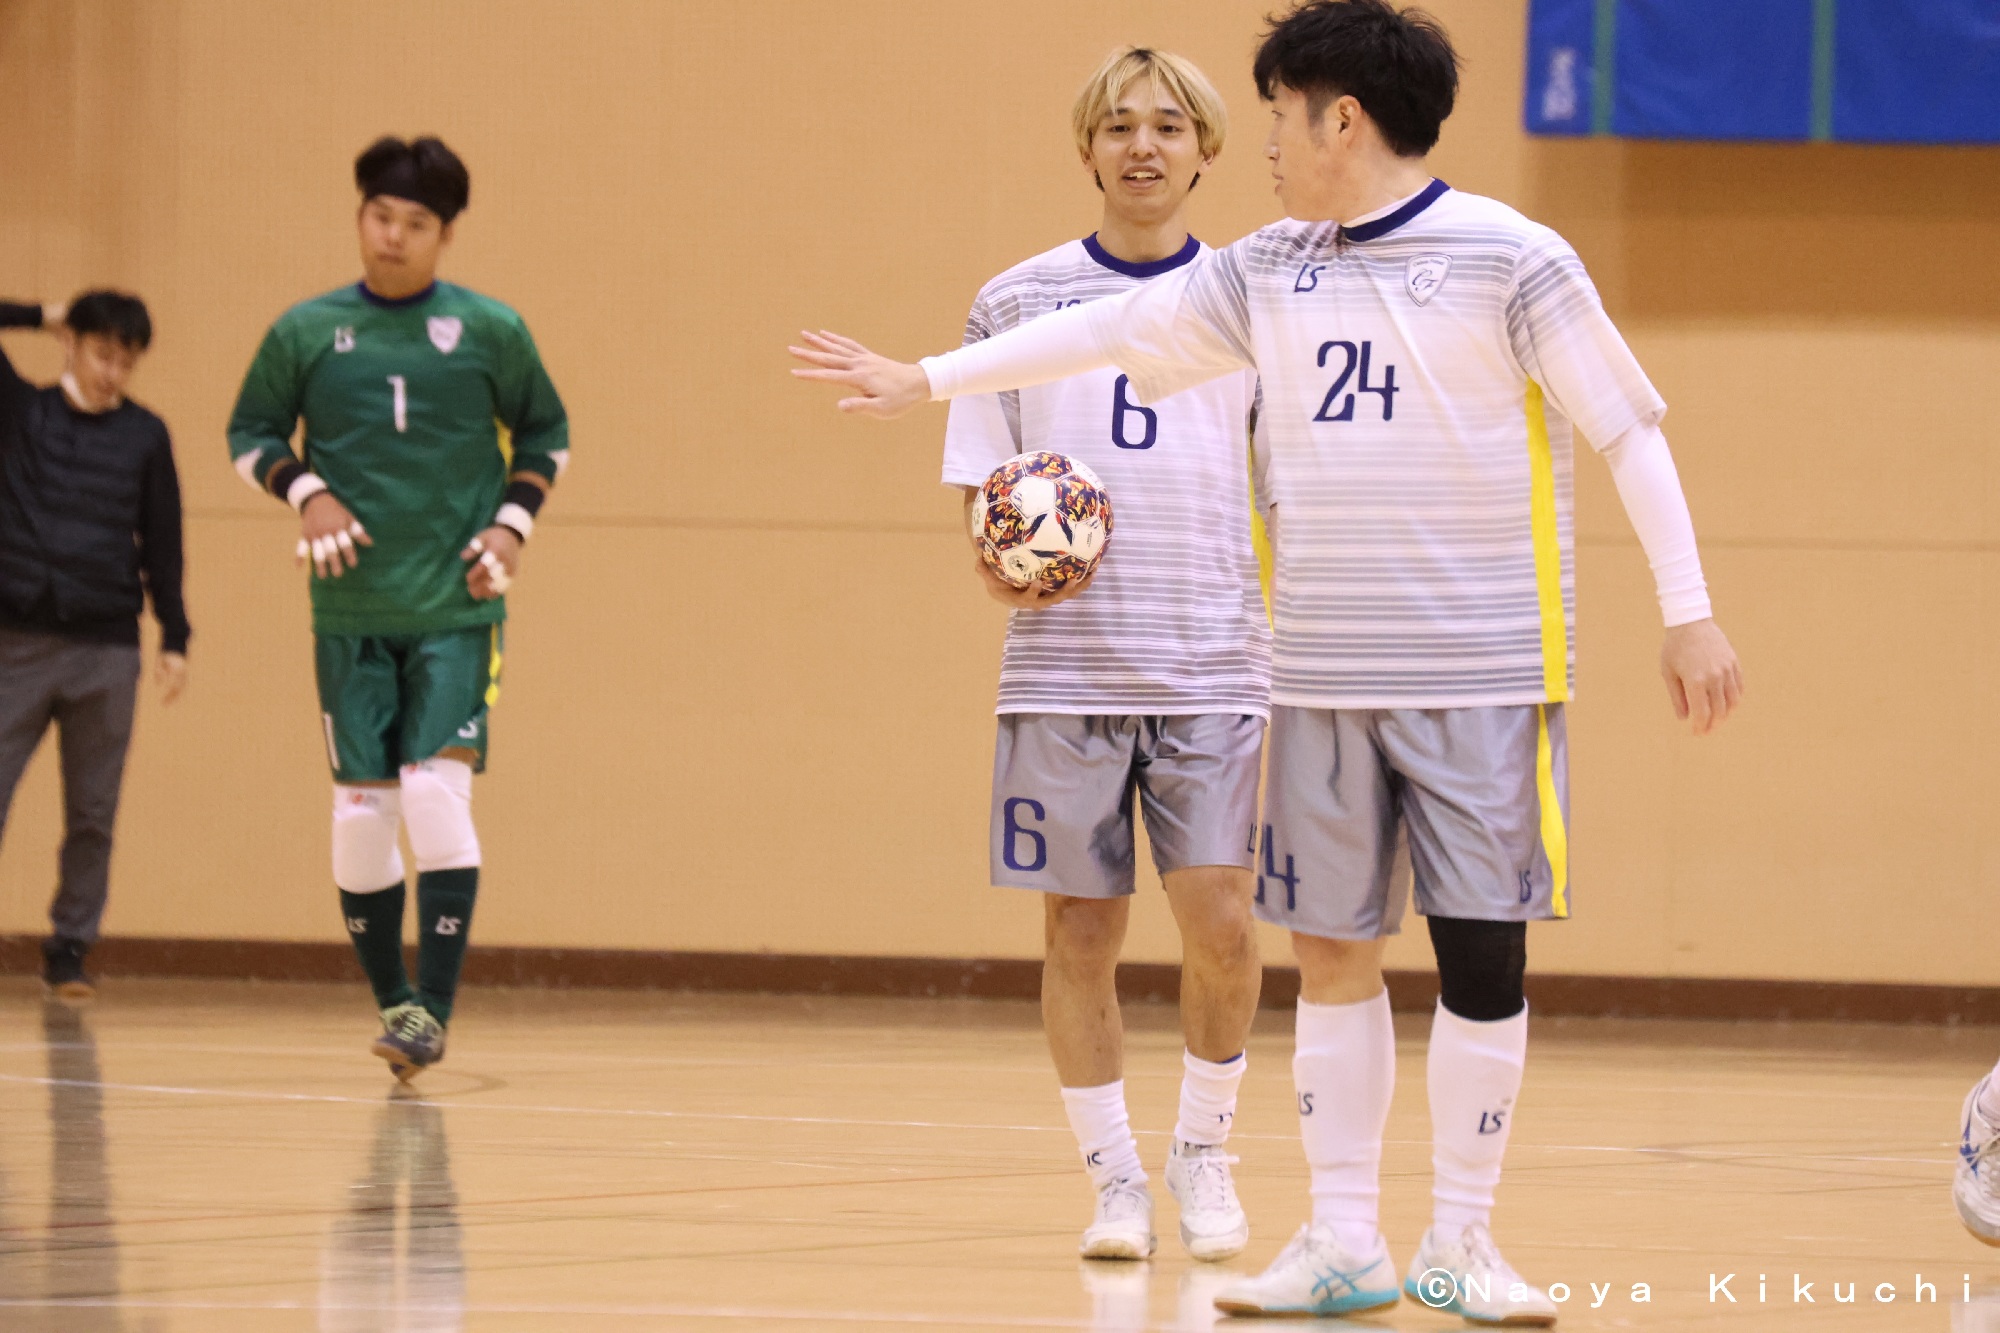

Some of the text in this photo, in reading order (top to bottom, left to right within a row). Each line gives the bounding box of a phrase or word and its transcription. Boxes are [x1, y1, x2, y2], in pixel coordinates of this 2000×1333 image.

[387, 375, 407, 433] 1
[1112, 373, 1157, 449] 6
[1312, 341, 1399, 421] 24
[1003, 797, 1047, 871] 6
